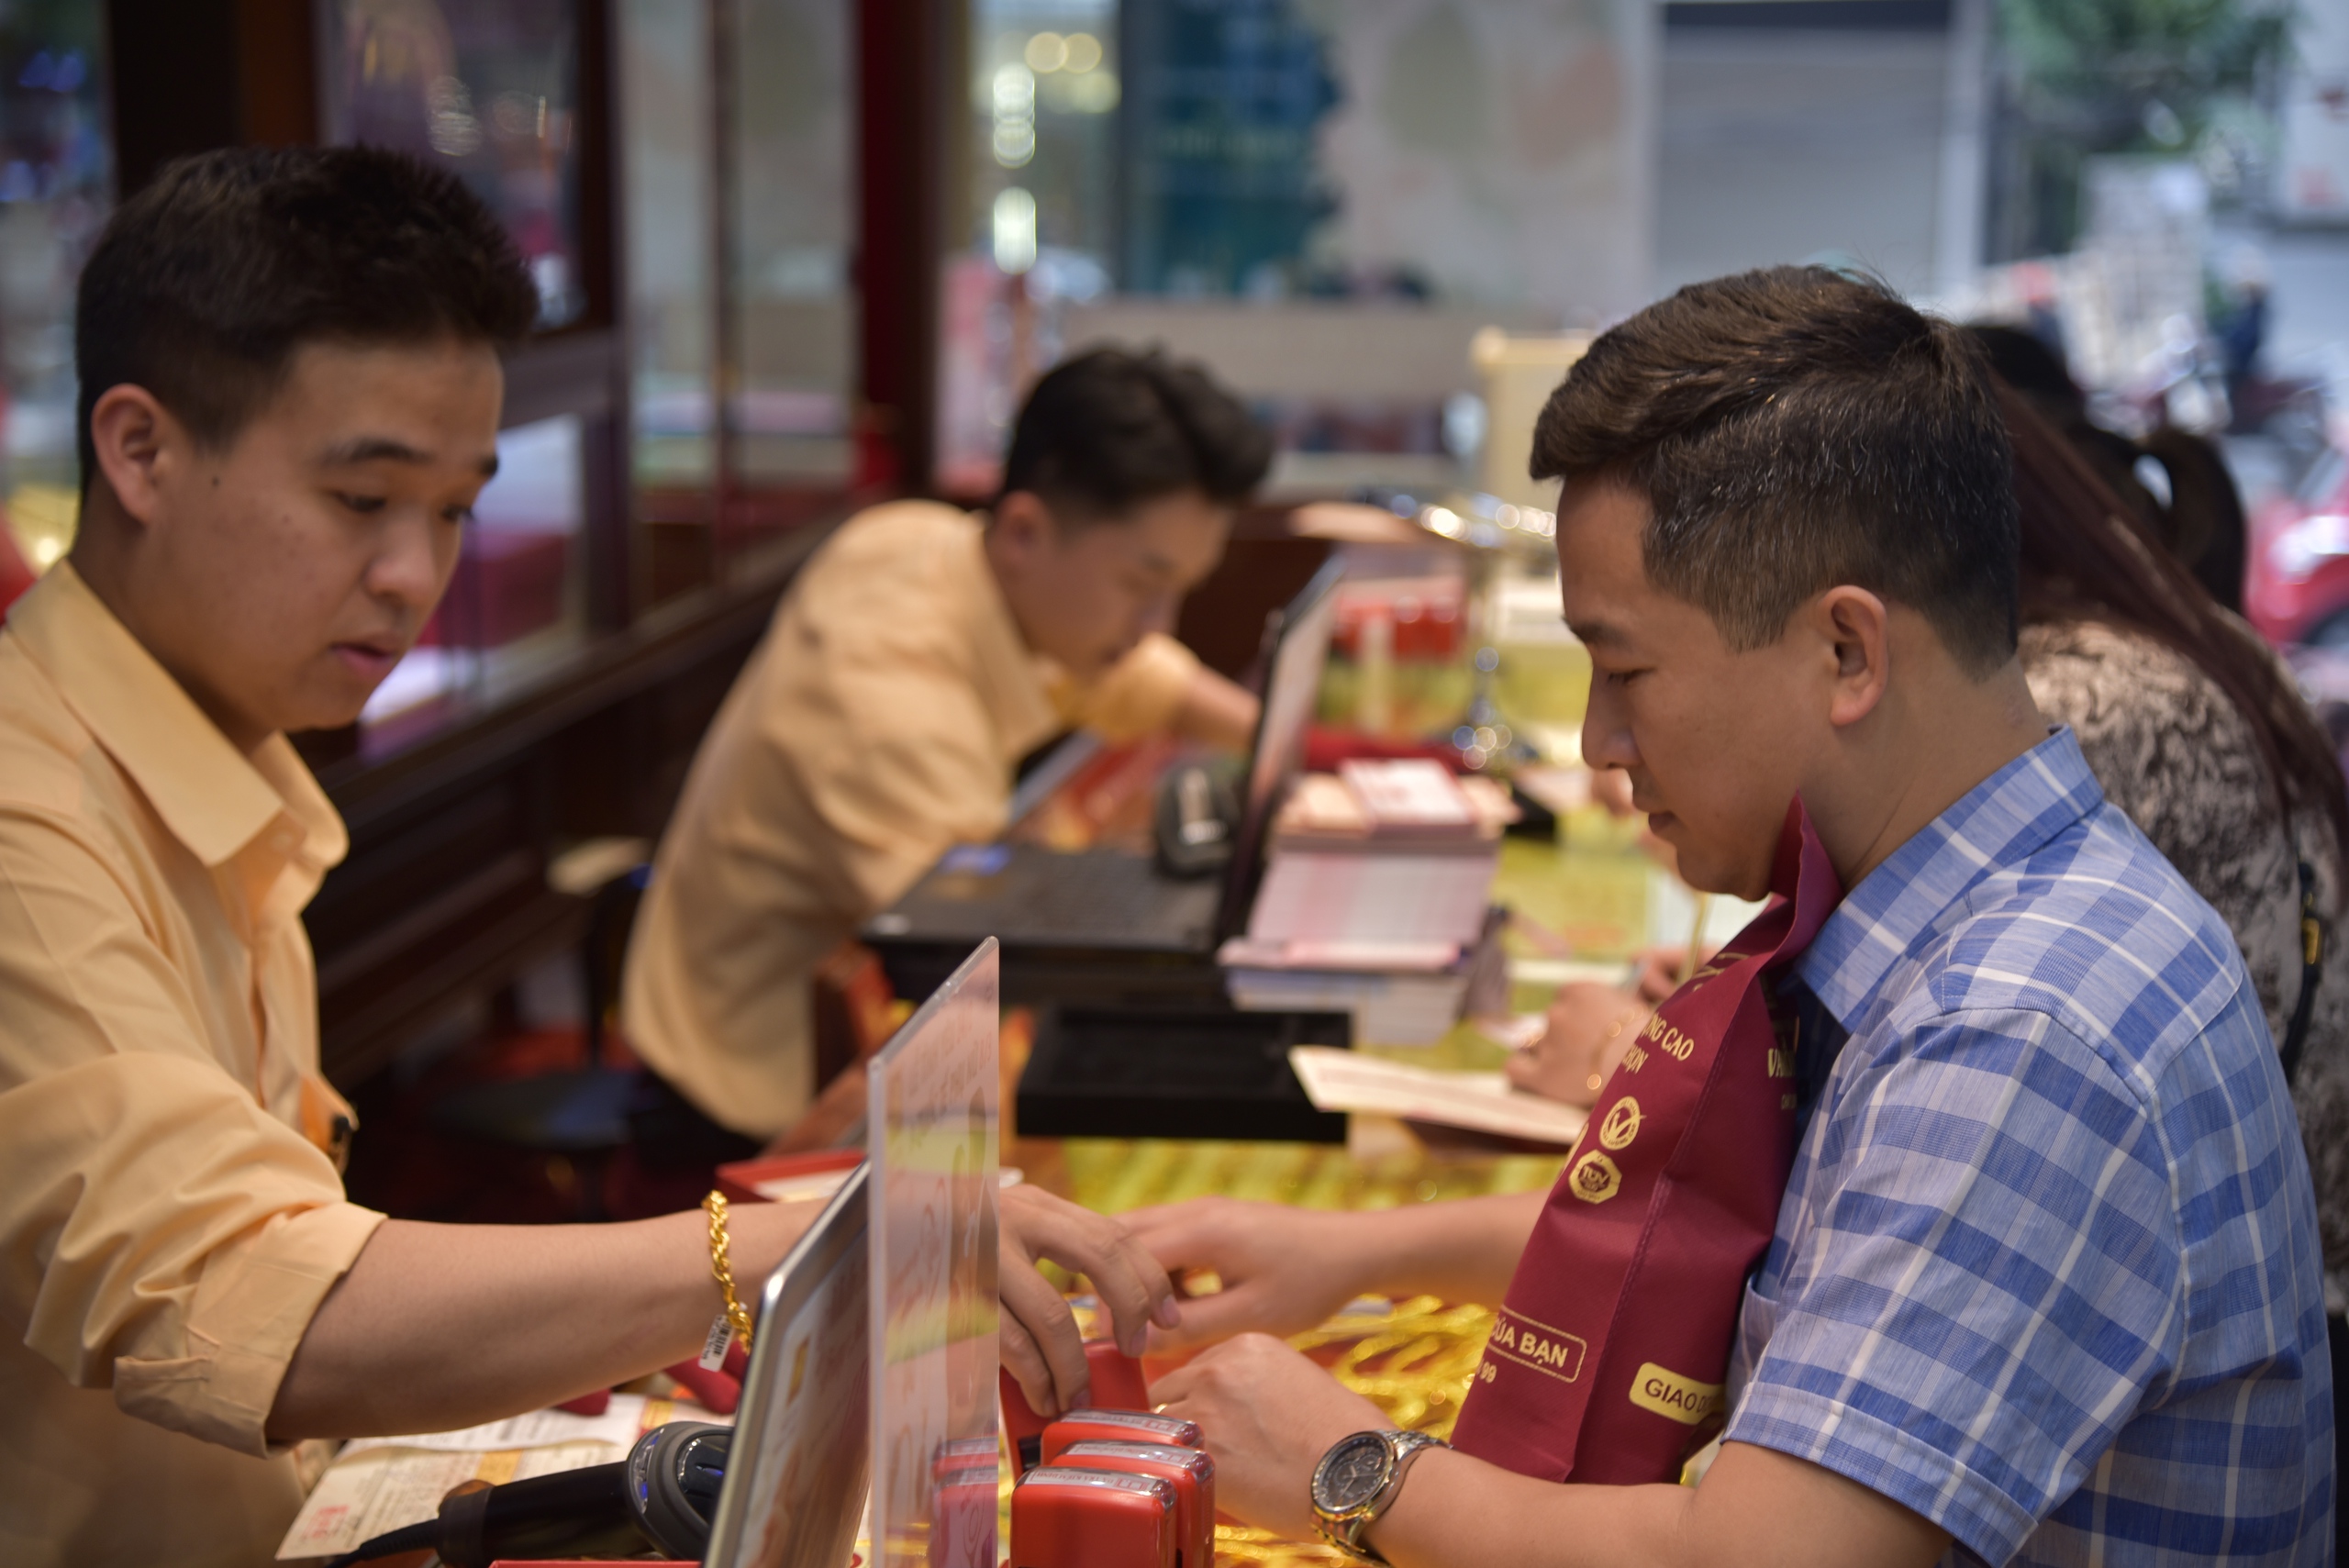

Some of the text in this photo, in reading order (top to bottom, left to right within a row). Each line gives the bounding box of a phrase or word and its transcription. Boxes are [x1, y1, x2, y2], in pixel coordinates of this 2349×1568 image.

[1641, 1011, 1695, 1061] NG CAO
[1519, 1331, 1568, 1368] BẠN
[1644, 1378, 1698, 1411] GIAO
